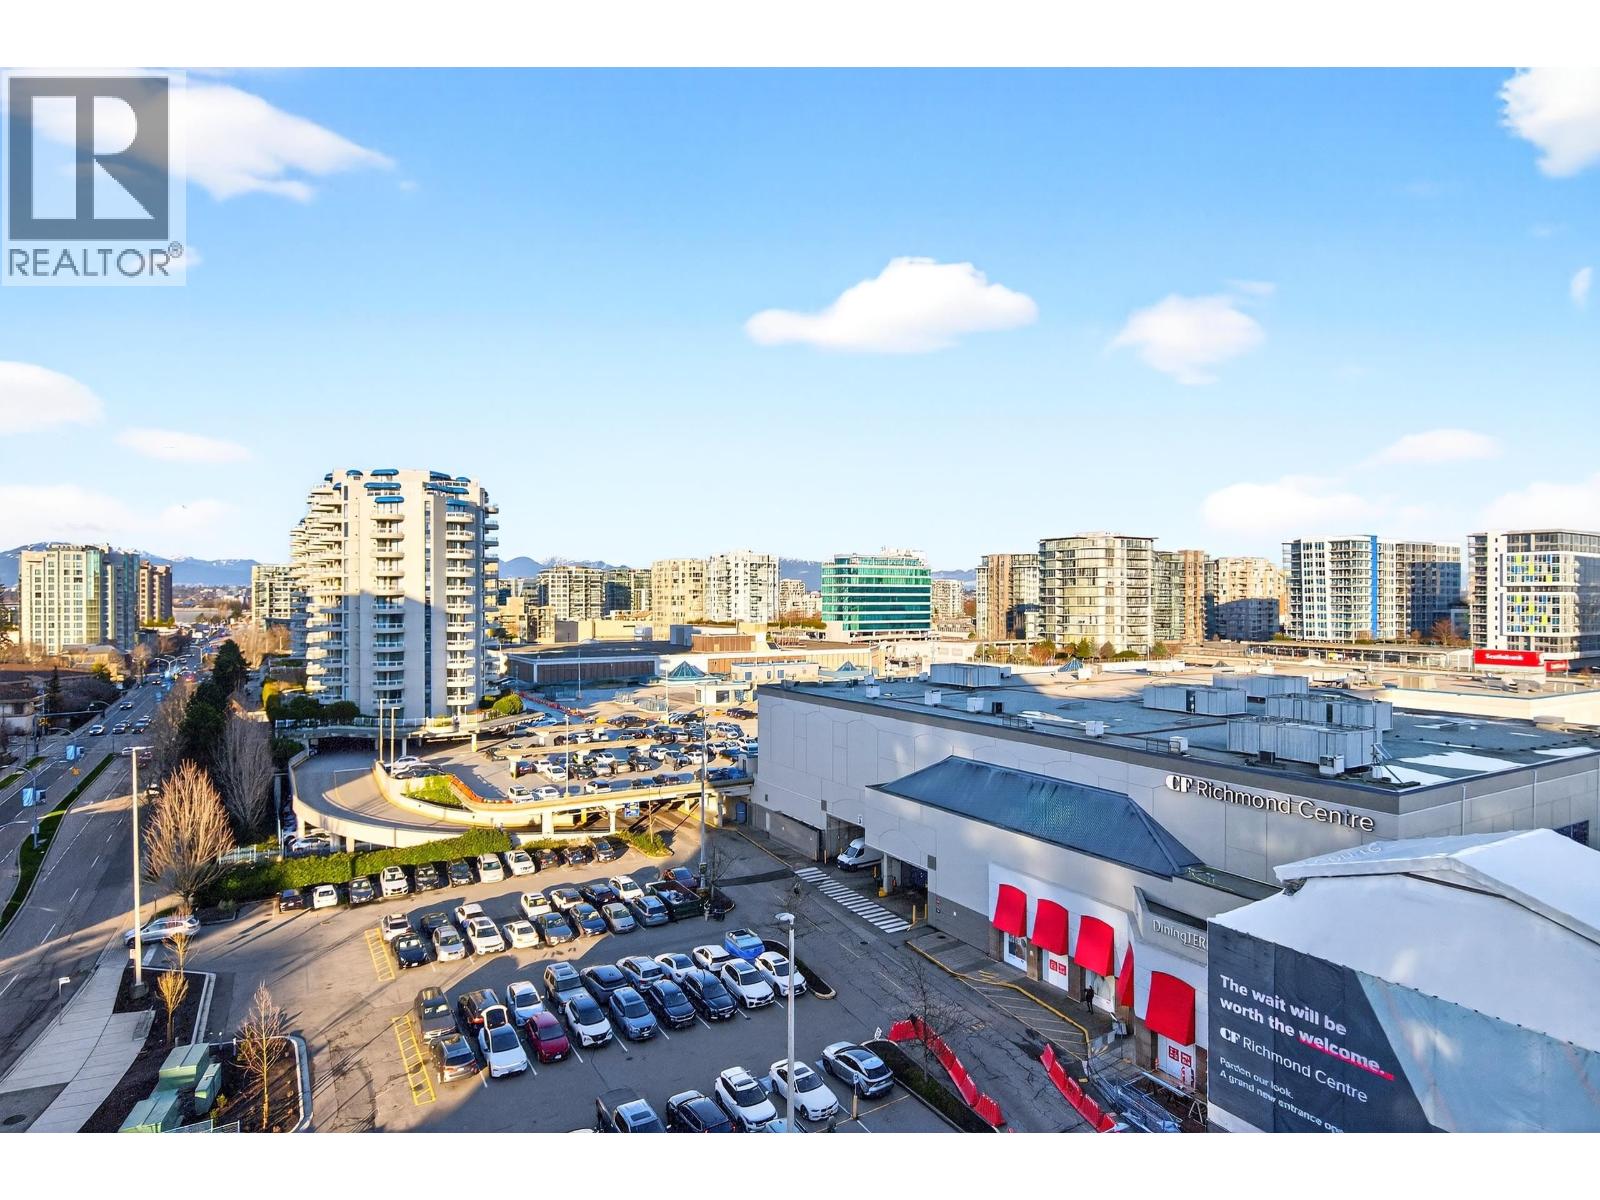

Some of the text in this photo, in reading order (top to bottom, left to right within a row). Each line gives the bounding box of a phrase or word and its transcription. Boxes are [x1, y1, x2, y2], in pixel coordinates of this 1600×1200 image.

[1165, 774, 1375, 832] CF Richmond Centre
[1220, 974, 1347, 1036] The wait will be
[1219, 998, 1385, 1075] worth the welcome.
[1220, 1027, 1368, 1103] CF Richmond Centre
[1219, 1069, 1227, 1079] A
[1228, 1075, 1255, 1093] grand
[1256, 1088, 1276, 1103] new
[1278, 1099, 1322, 1126] entrance
[1220, 1056, 1294, 1099] Pardon our look.
